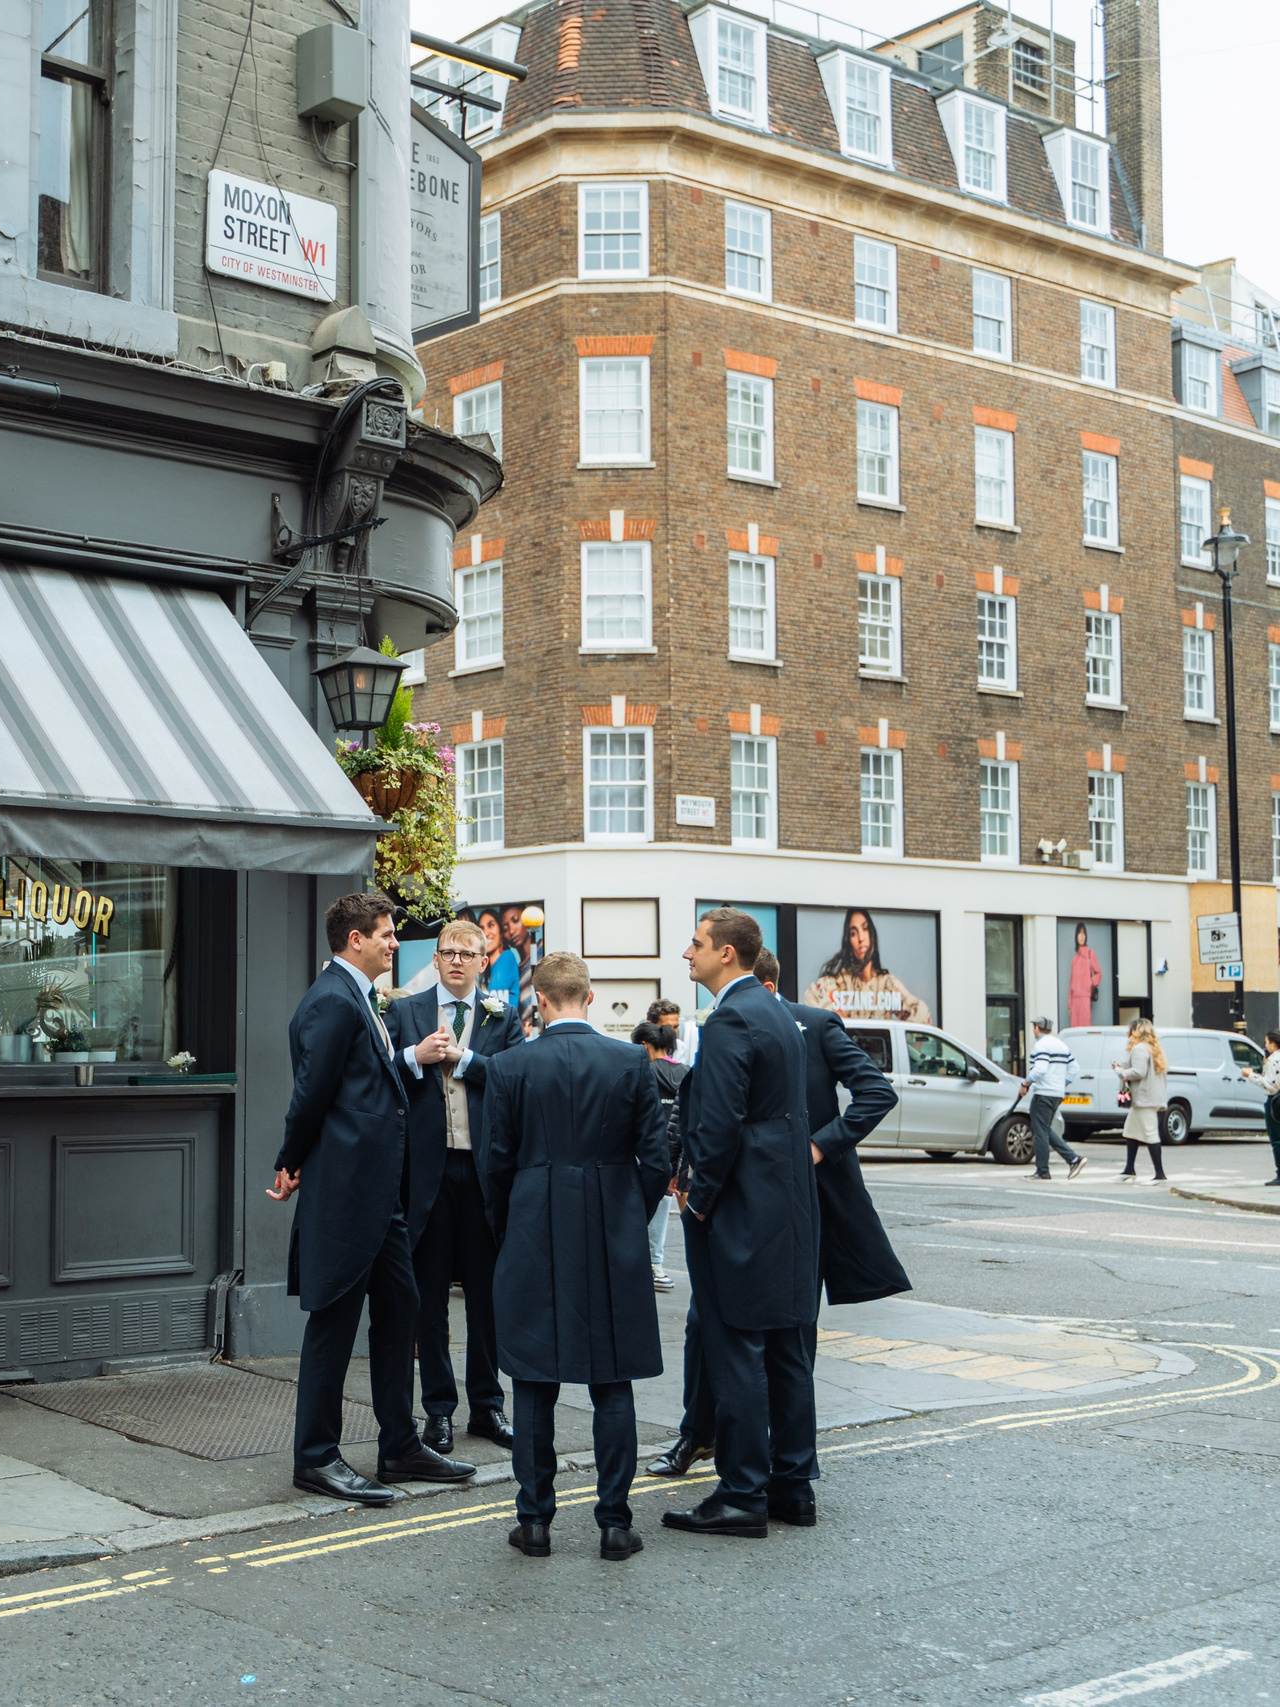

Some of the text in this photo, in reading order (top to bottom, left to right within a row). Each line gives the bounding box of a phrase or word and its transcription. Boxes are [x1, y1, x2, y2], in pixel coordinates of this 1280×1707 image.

[426, 154, 440, 164] 1863
[224, 183, 291, 225] MOXON
[223, 215, 326, 266] STREET W1
[222, 255, 318, 292] CITY OF WESTMINSTER
[1231, 966, 1239, 976] P
[832, 990, 902, 1011] SEZANE.COM
